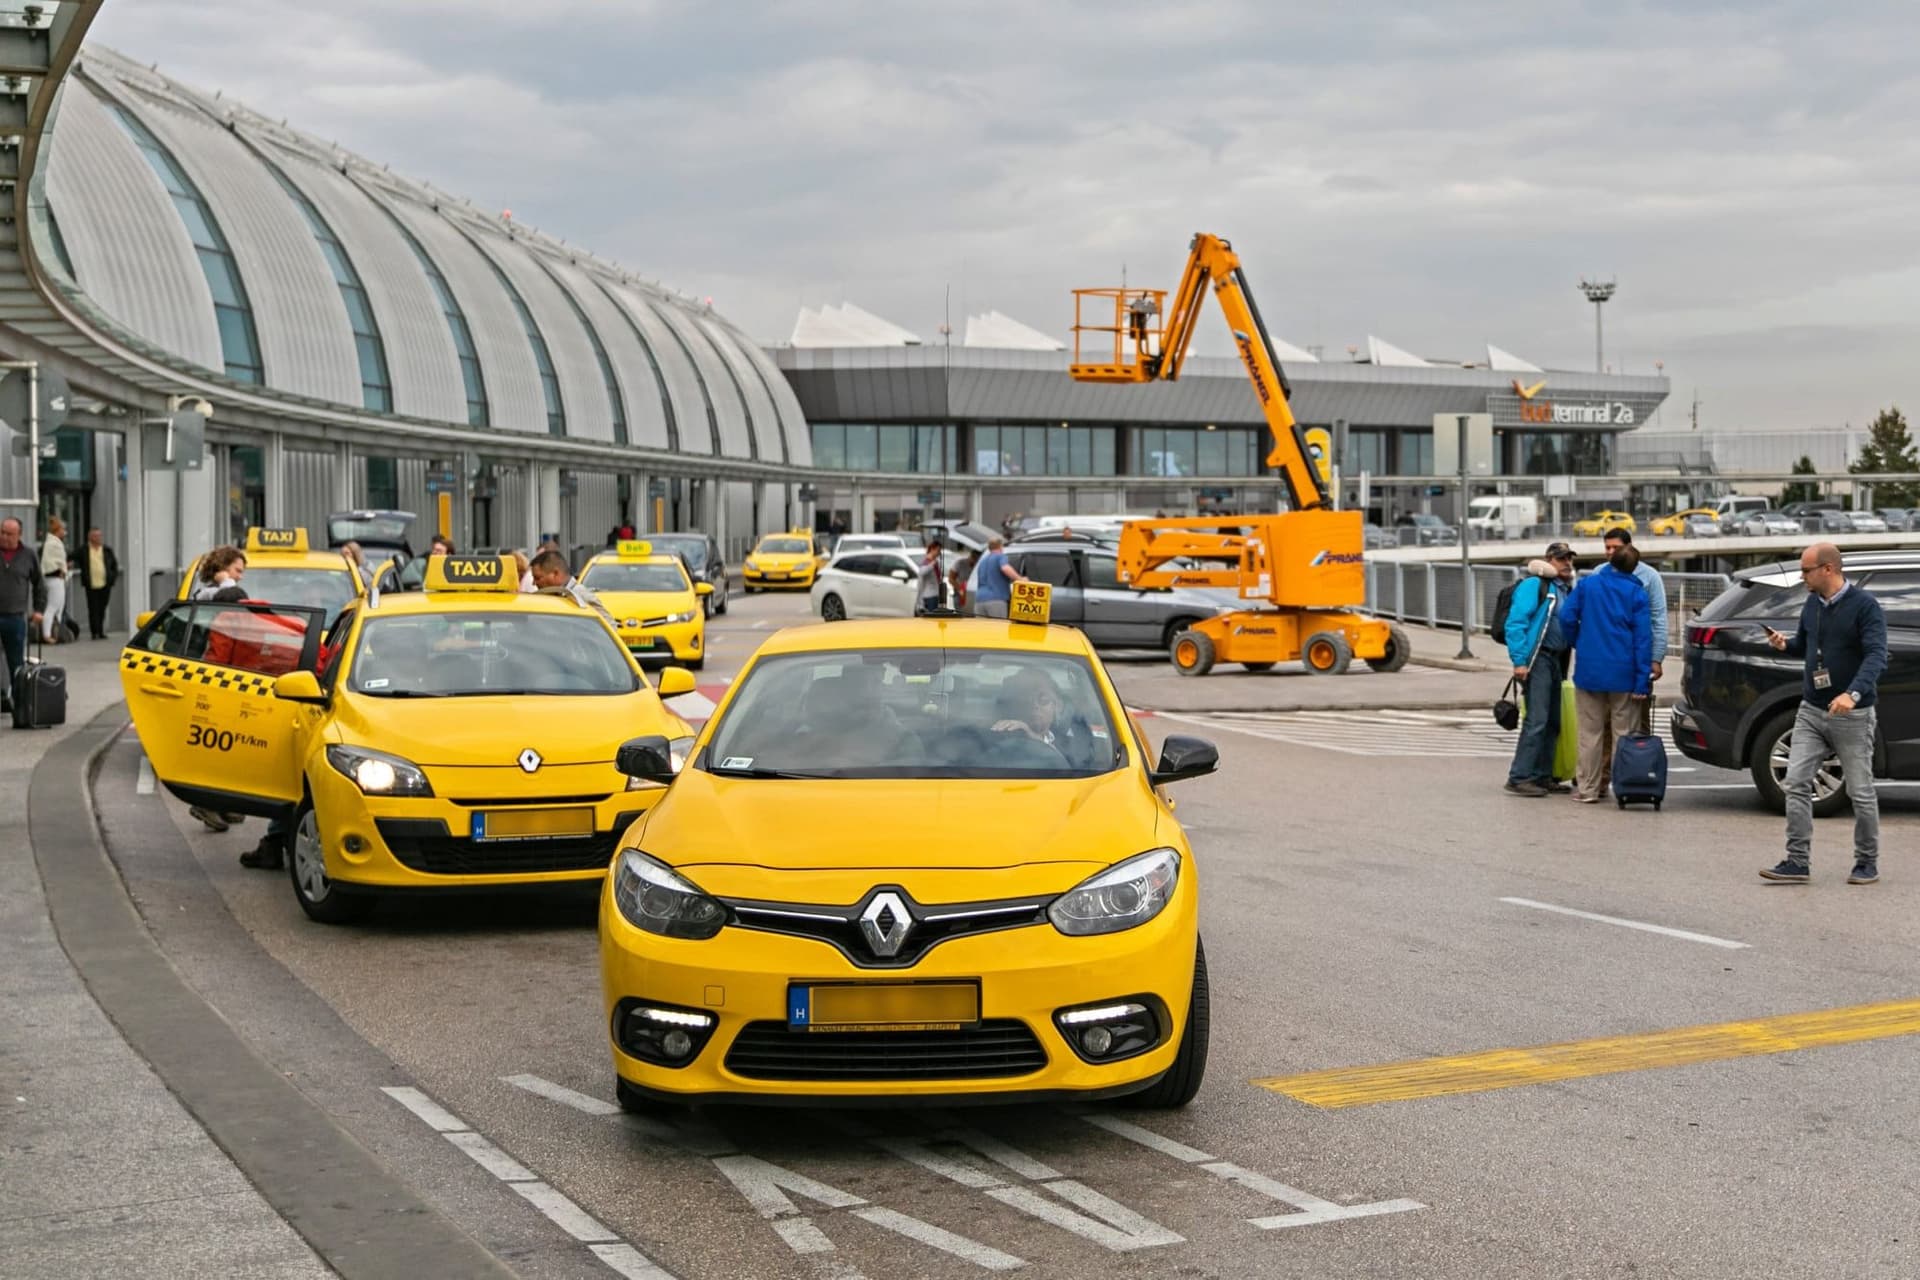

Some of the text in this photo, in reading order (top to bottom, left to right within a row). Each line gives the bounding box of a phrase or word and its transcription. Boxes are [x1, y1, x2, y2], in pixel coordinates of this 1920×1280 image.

[1613, 402, 1634, 424] 2a
[261, 530, 294, 544] TAXI
[450, 560, 497, 577] TAXI
[1016, 602, 1042, 614] TAXI
[186, 723, 268, 752] 300 Ft/km
[796, 1008, 805, 1019] H
